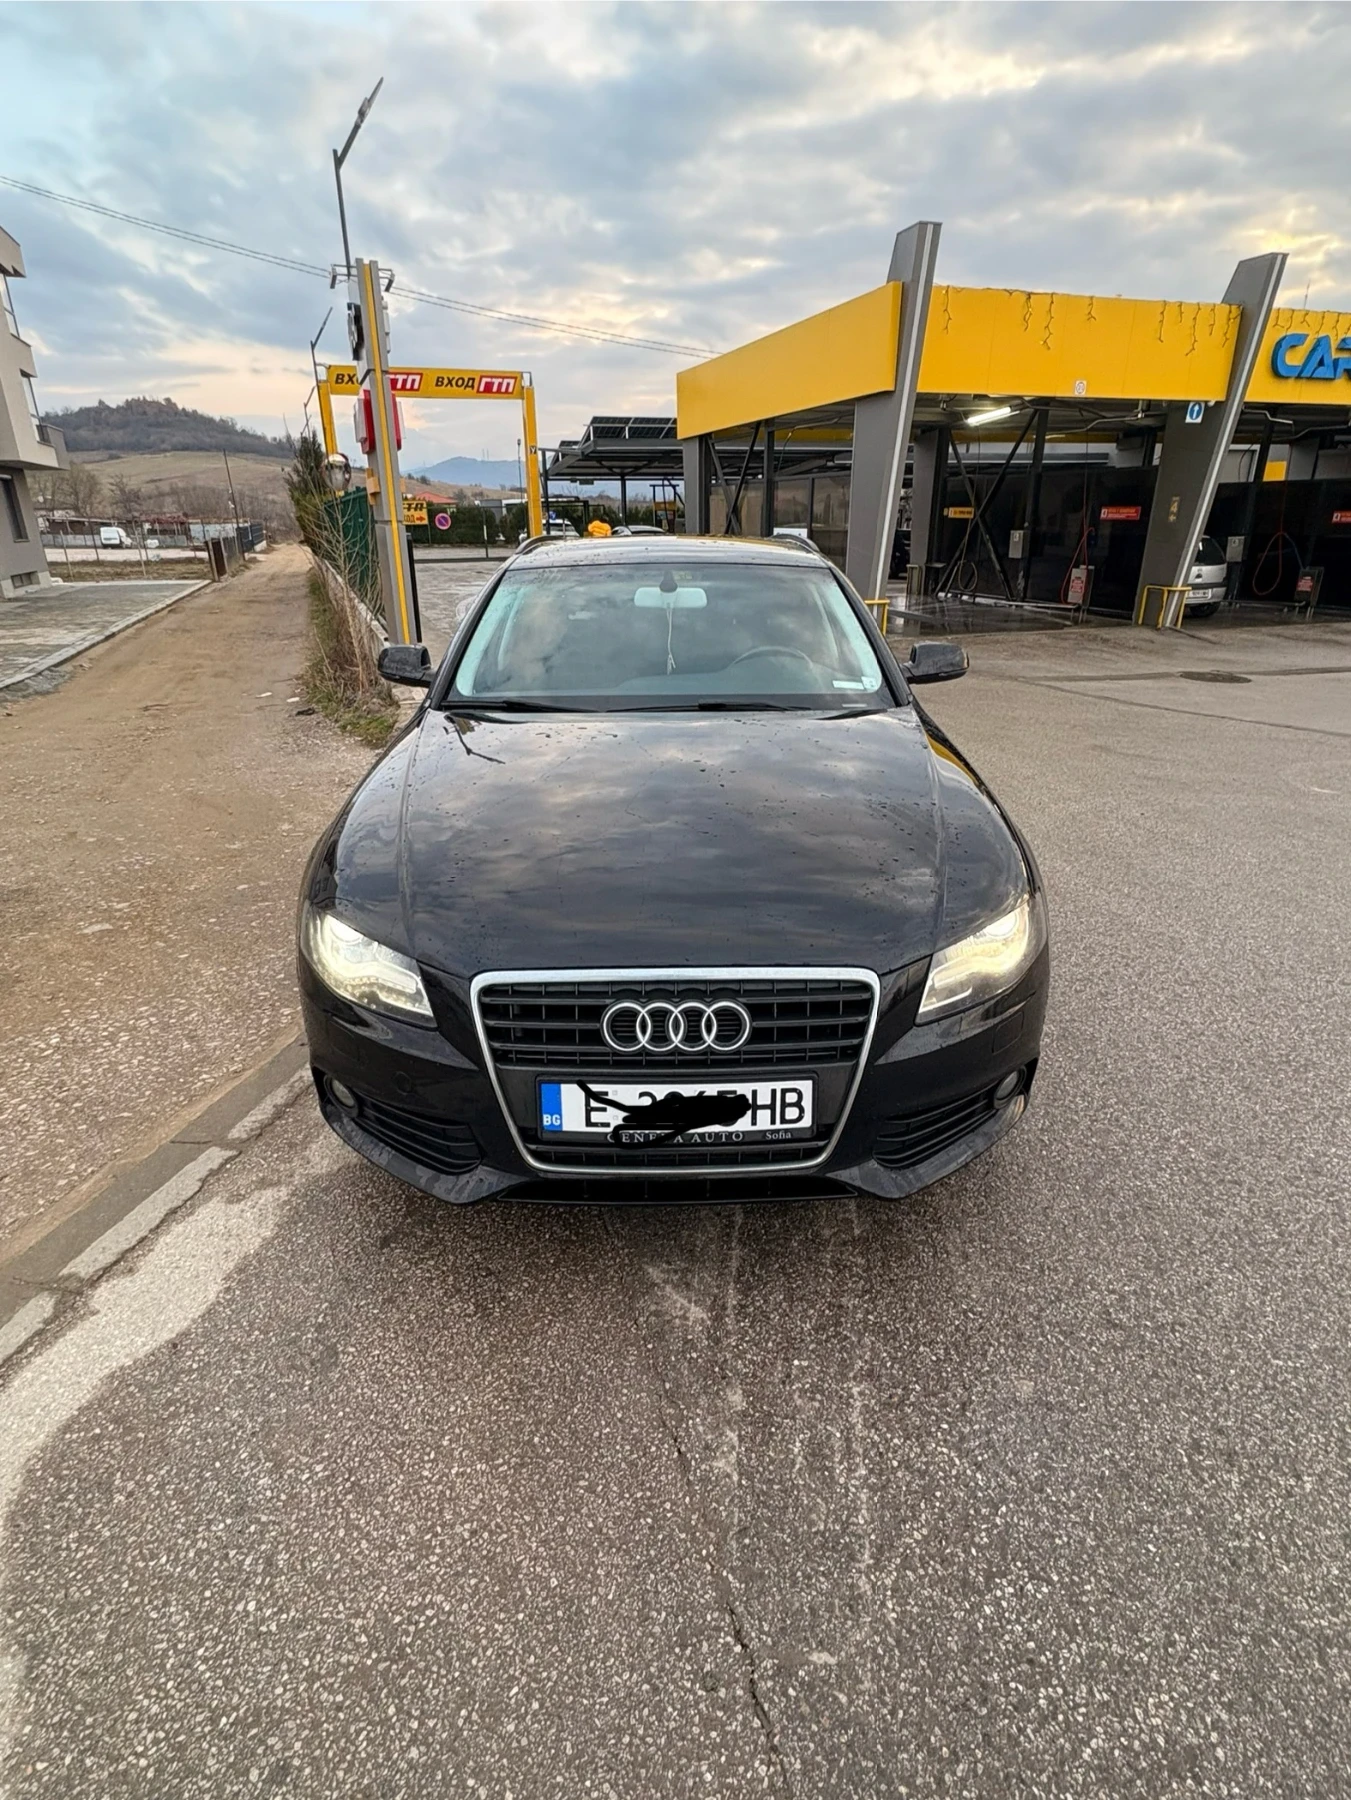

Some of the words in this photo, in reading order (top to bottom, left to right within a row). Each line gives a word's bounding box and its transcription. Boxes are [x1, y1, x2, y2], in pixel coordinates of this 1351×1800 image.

[335, 373, 359, 385] ВХ
[435, 376, 476, 390] ВХОД
[479, 377, 516, 393] ГТП
[403, 502, 424, 512] ТП
[585, 1091, 611, 1128] E
[750, 1087, 806, 1127] HB
[542, 1114, 561, 1126] BG
[607, 1131, 684, 1144] ENEA
[691, 1131, 744, 1144] AUTO
[765, 1130, 792, 1141] Sofia
